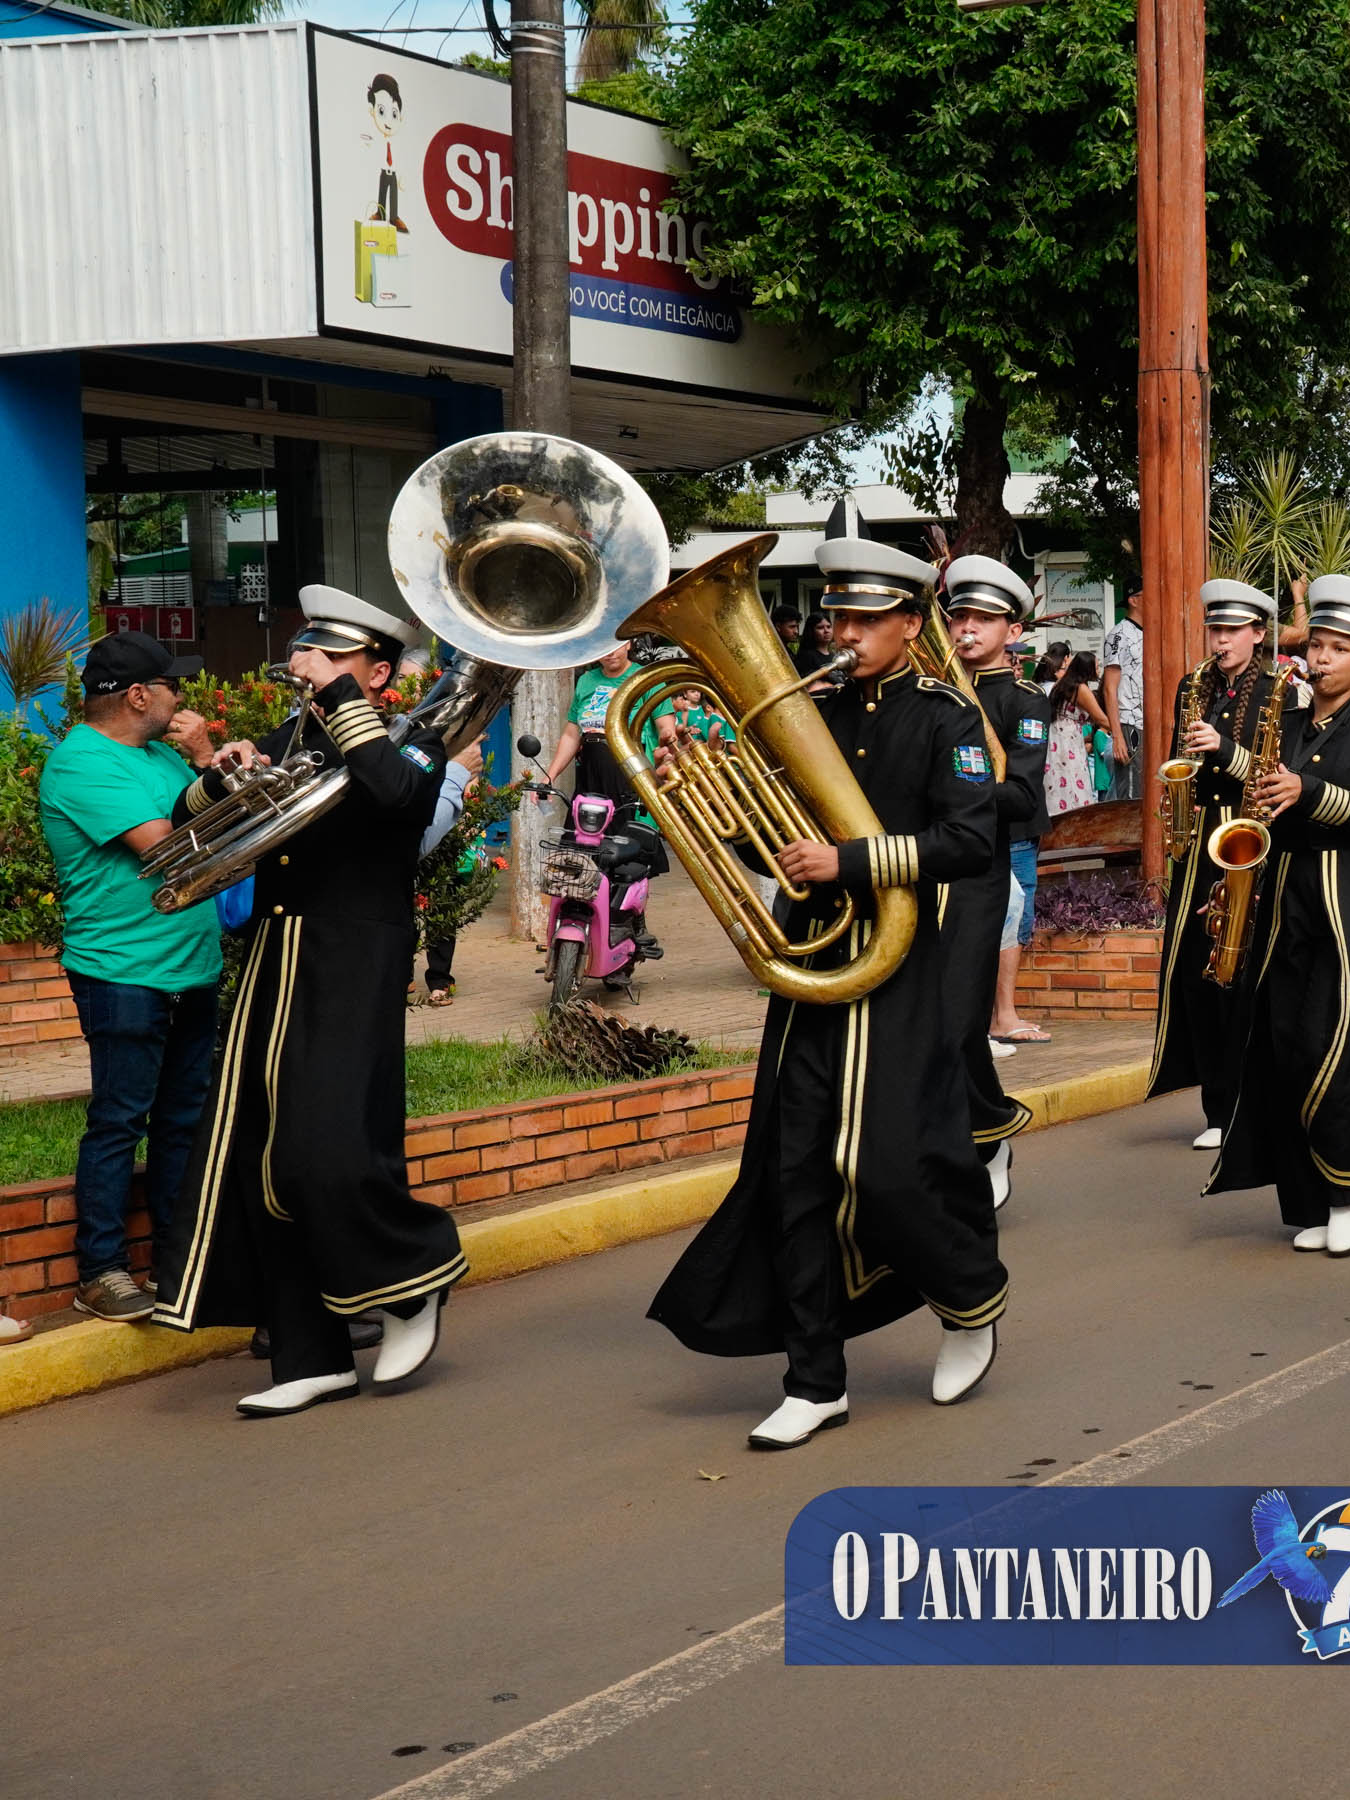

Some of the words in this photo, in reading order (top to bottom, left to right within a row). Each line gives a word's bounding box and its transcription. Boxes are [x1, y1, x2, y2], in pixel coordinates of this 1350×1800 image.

[445, 143, 720, 290] Shpping
[587, 289, 627, 315] VOCÊ
[629, 297, 662, 320] COM
[664, 302, 736, 334] ELEGÂNCIA
